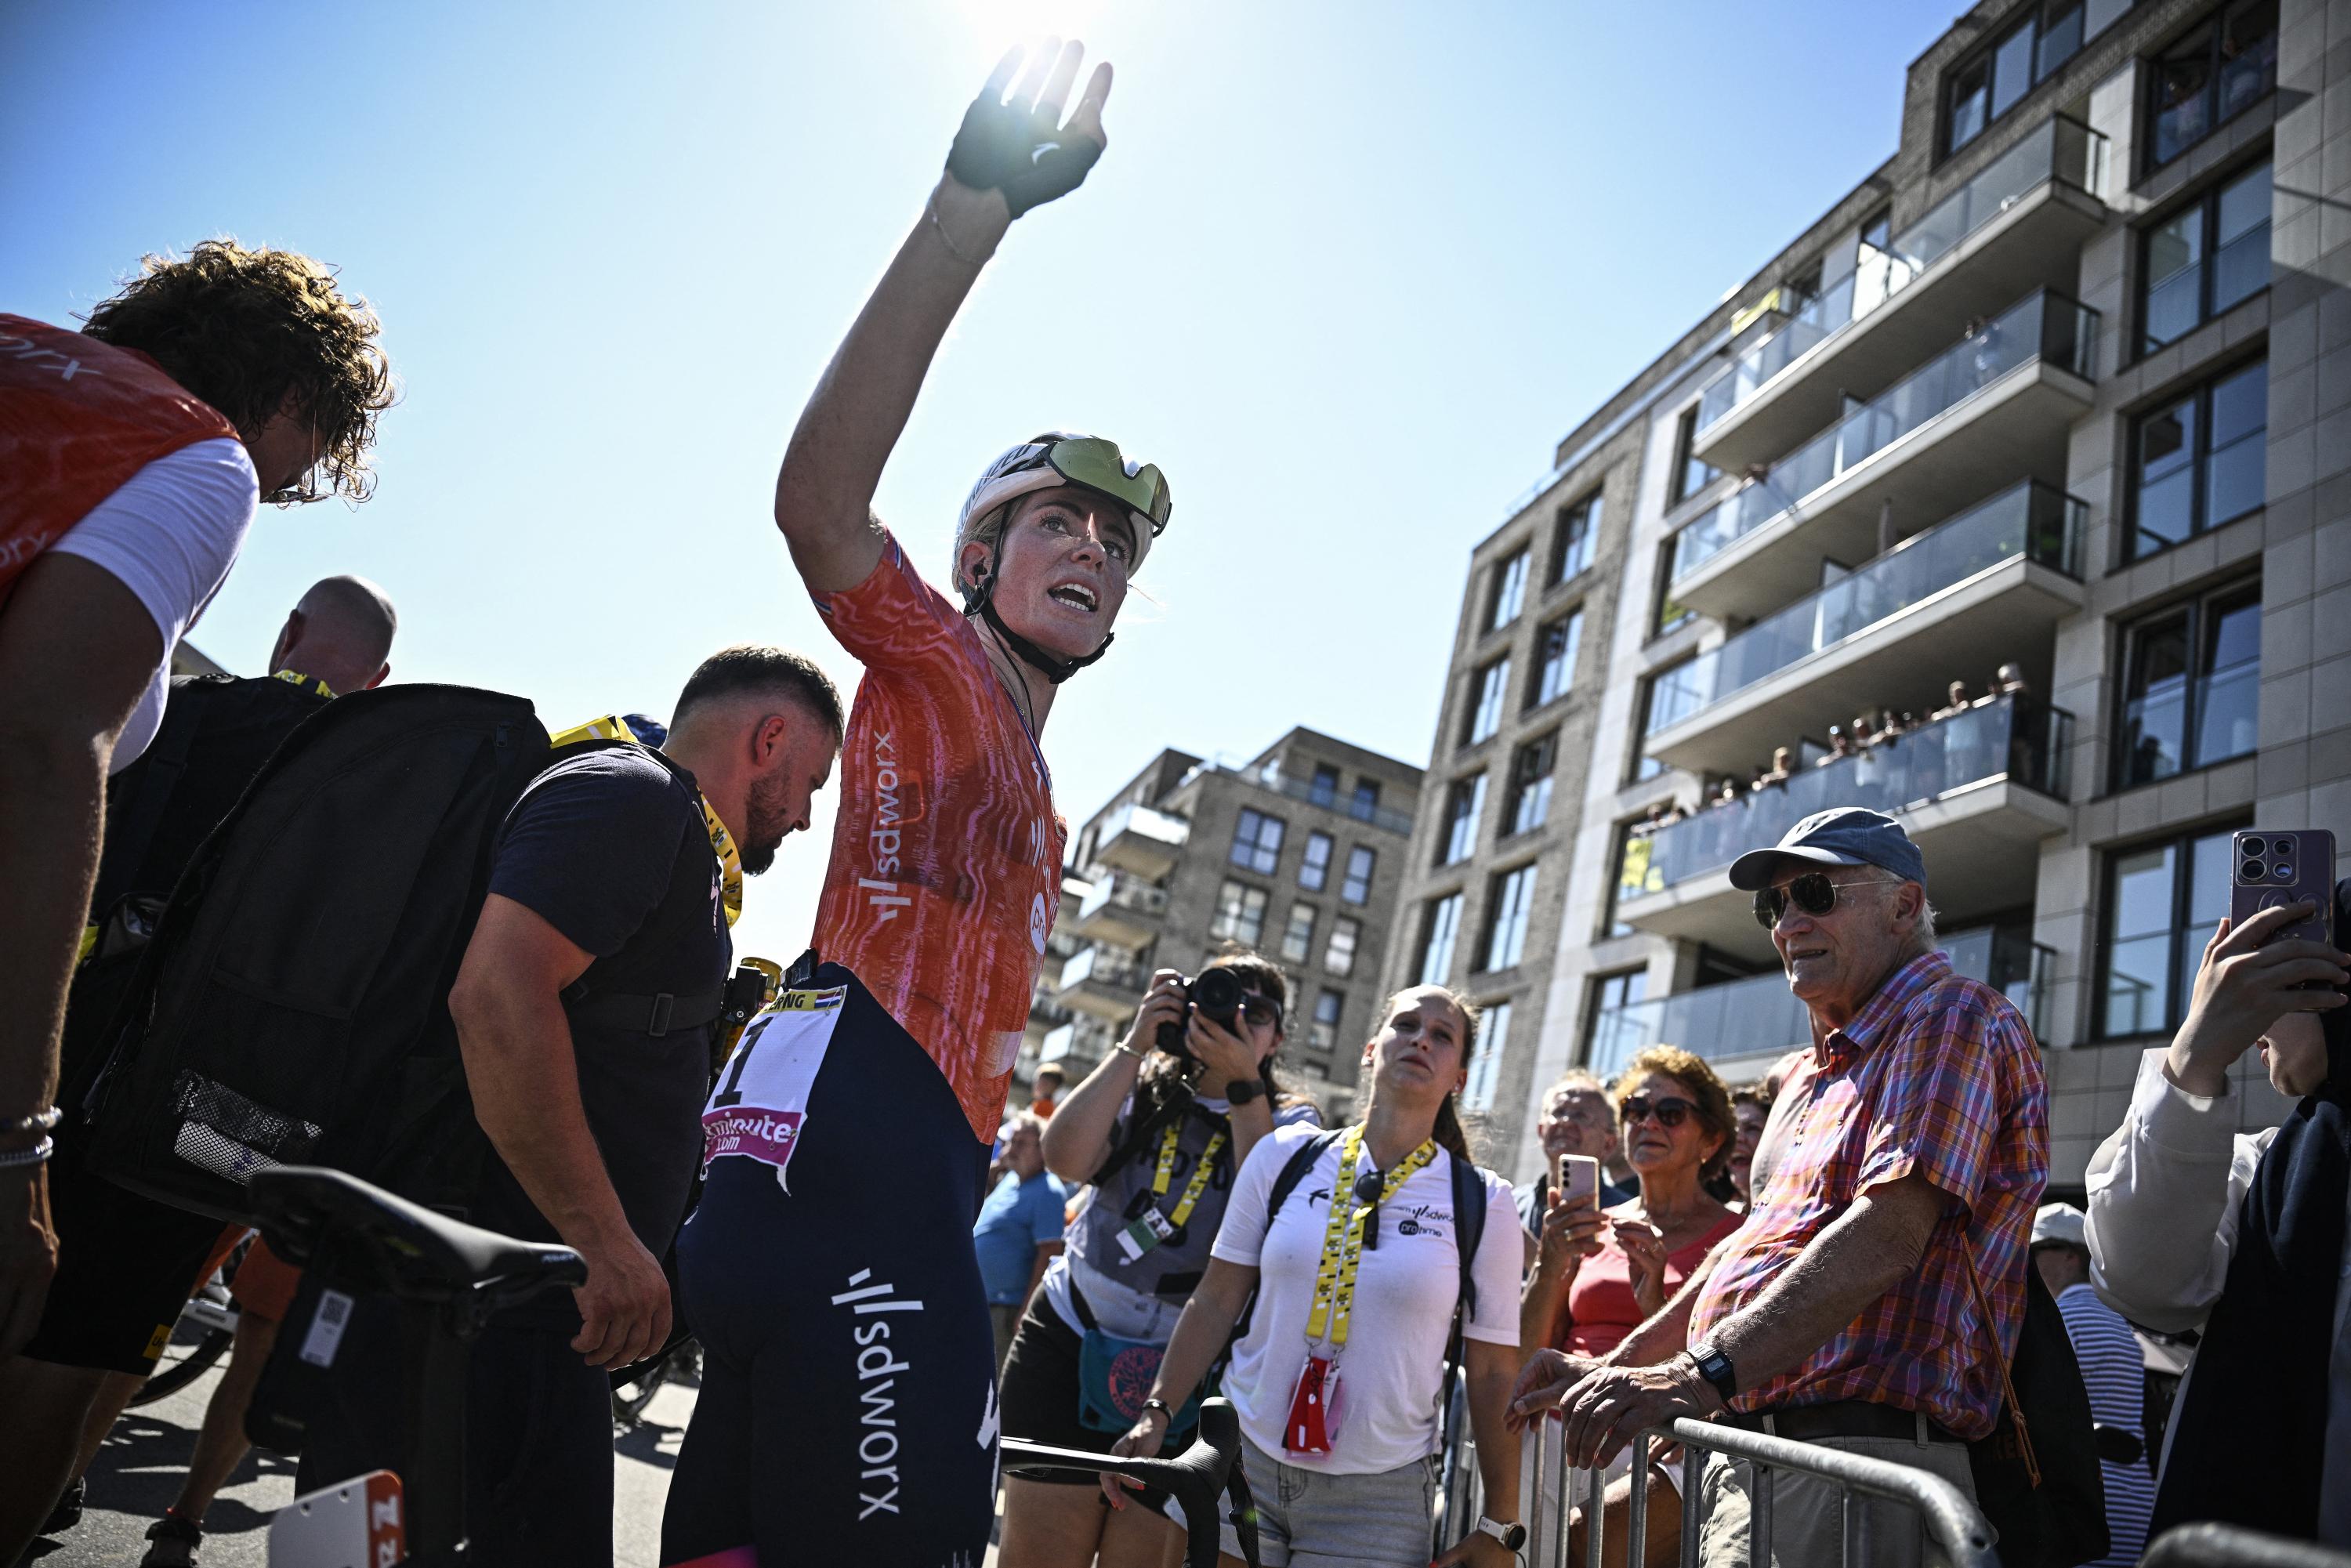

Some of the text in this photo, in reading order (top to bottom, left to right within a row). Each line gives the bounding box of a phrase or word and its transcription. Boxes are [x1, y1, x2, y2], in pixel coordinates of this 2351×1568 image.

[871, 730, 901, 874] sdworx
[713, 1016, 774, 1109] 1
[705, 1111, 792, 1143] minute
[853, 1321, 911, 1521] sdworx
